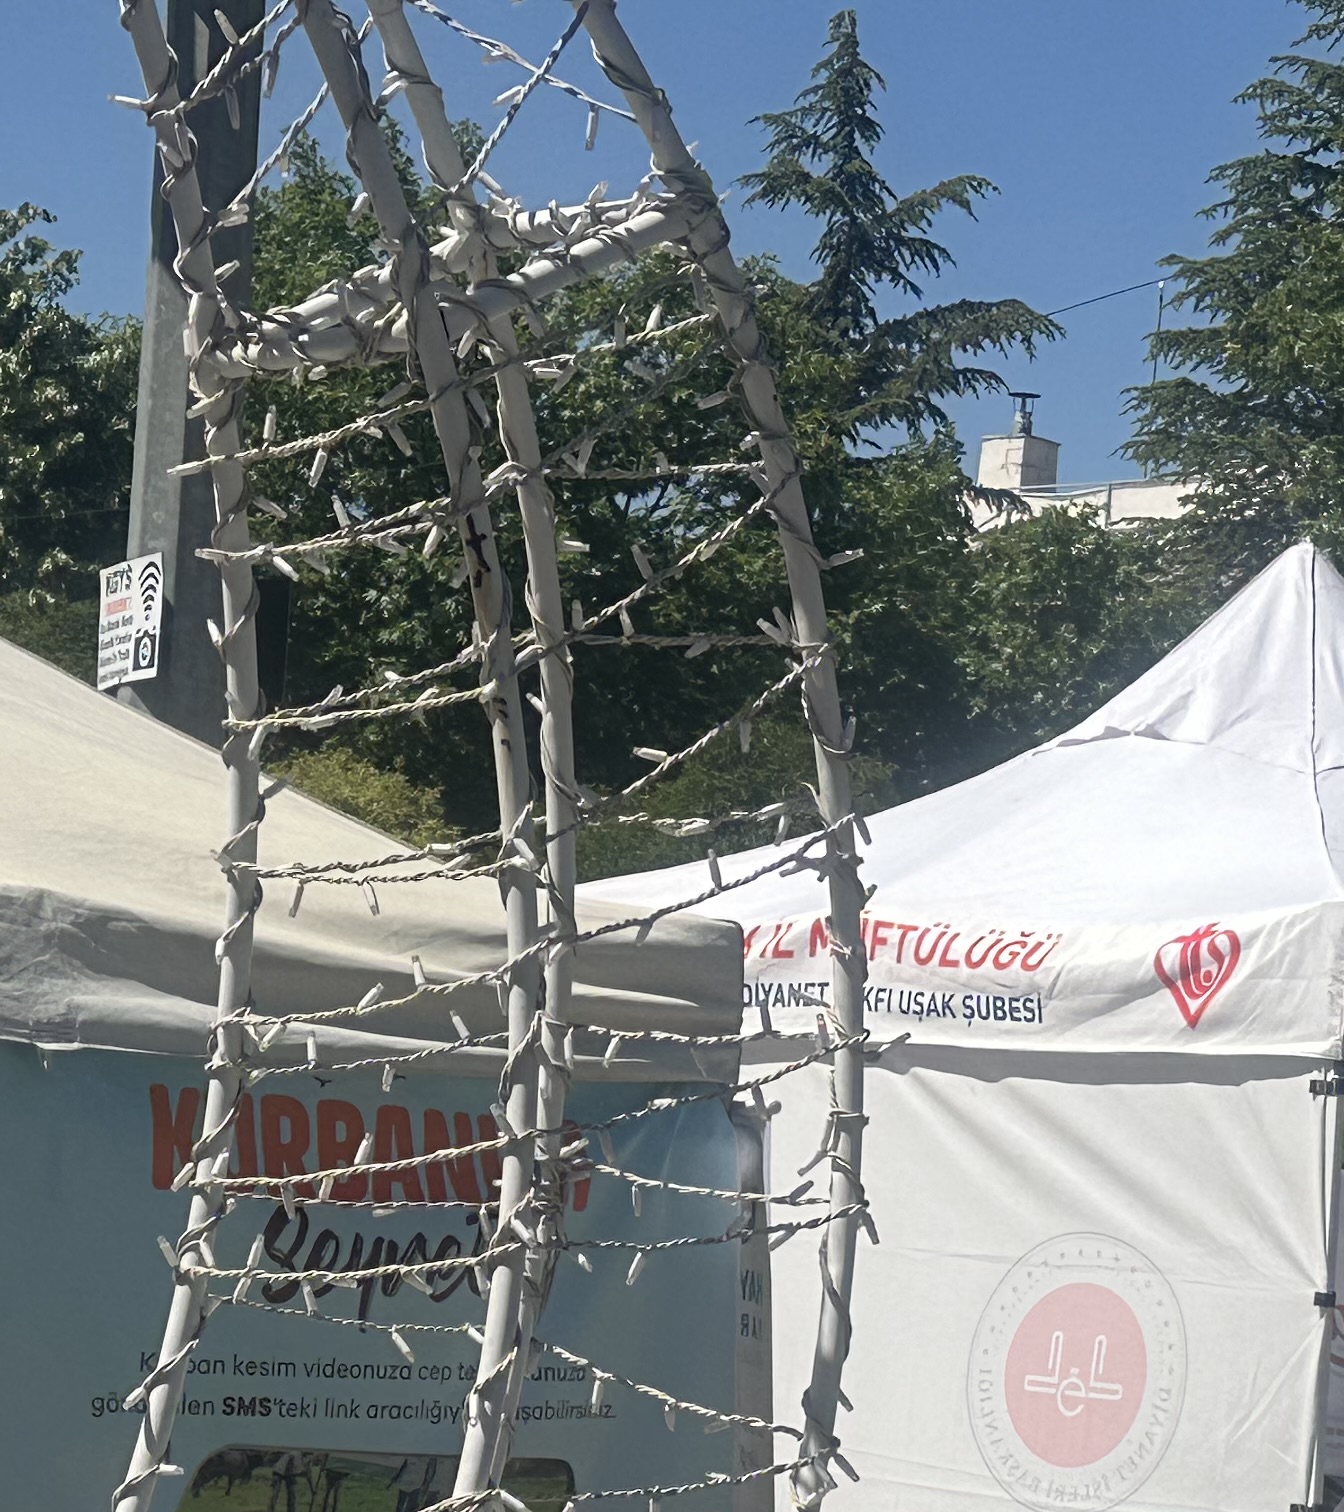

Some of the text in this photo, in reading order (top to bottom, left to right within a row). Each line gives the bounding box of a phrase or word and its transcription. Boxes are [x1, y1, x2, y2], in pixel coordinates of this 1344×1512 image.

[808, 910, 1063, 972] MFTÜLÜĞÜ
[898, 990, 957, 1022] UŞAK
[962, 992, 1043, 1027] ŞUBESİ
[232, 1354, 296, 1378] kesim
[303, 1357, 412, 1382] videonuza
[417, 1364, 452, 1386] cep
[324, 1398, 361, 1420] link
